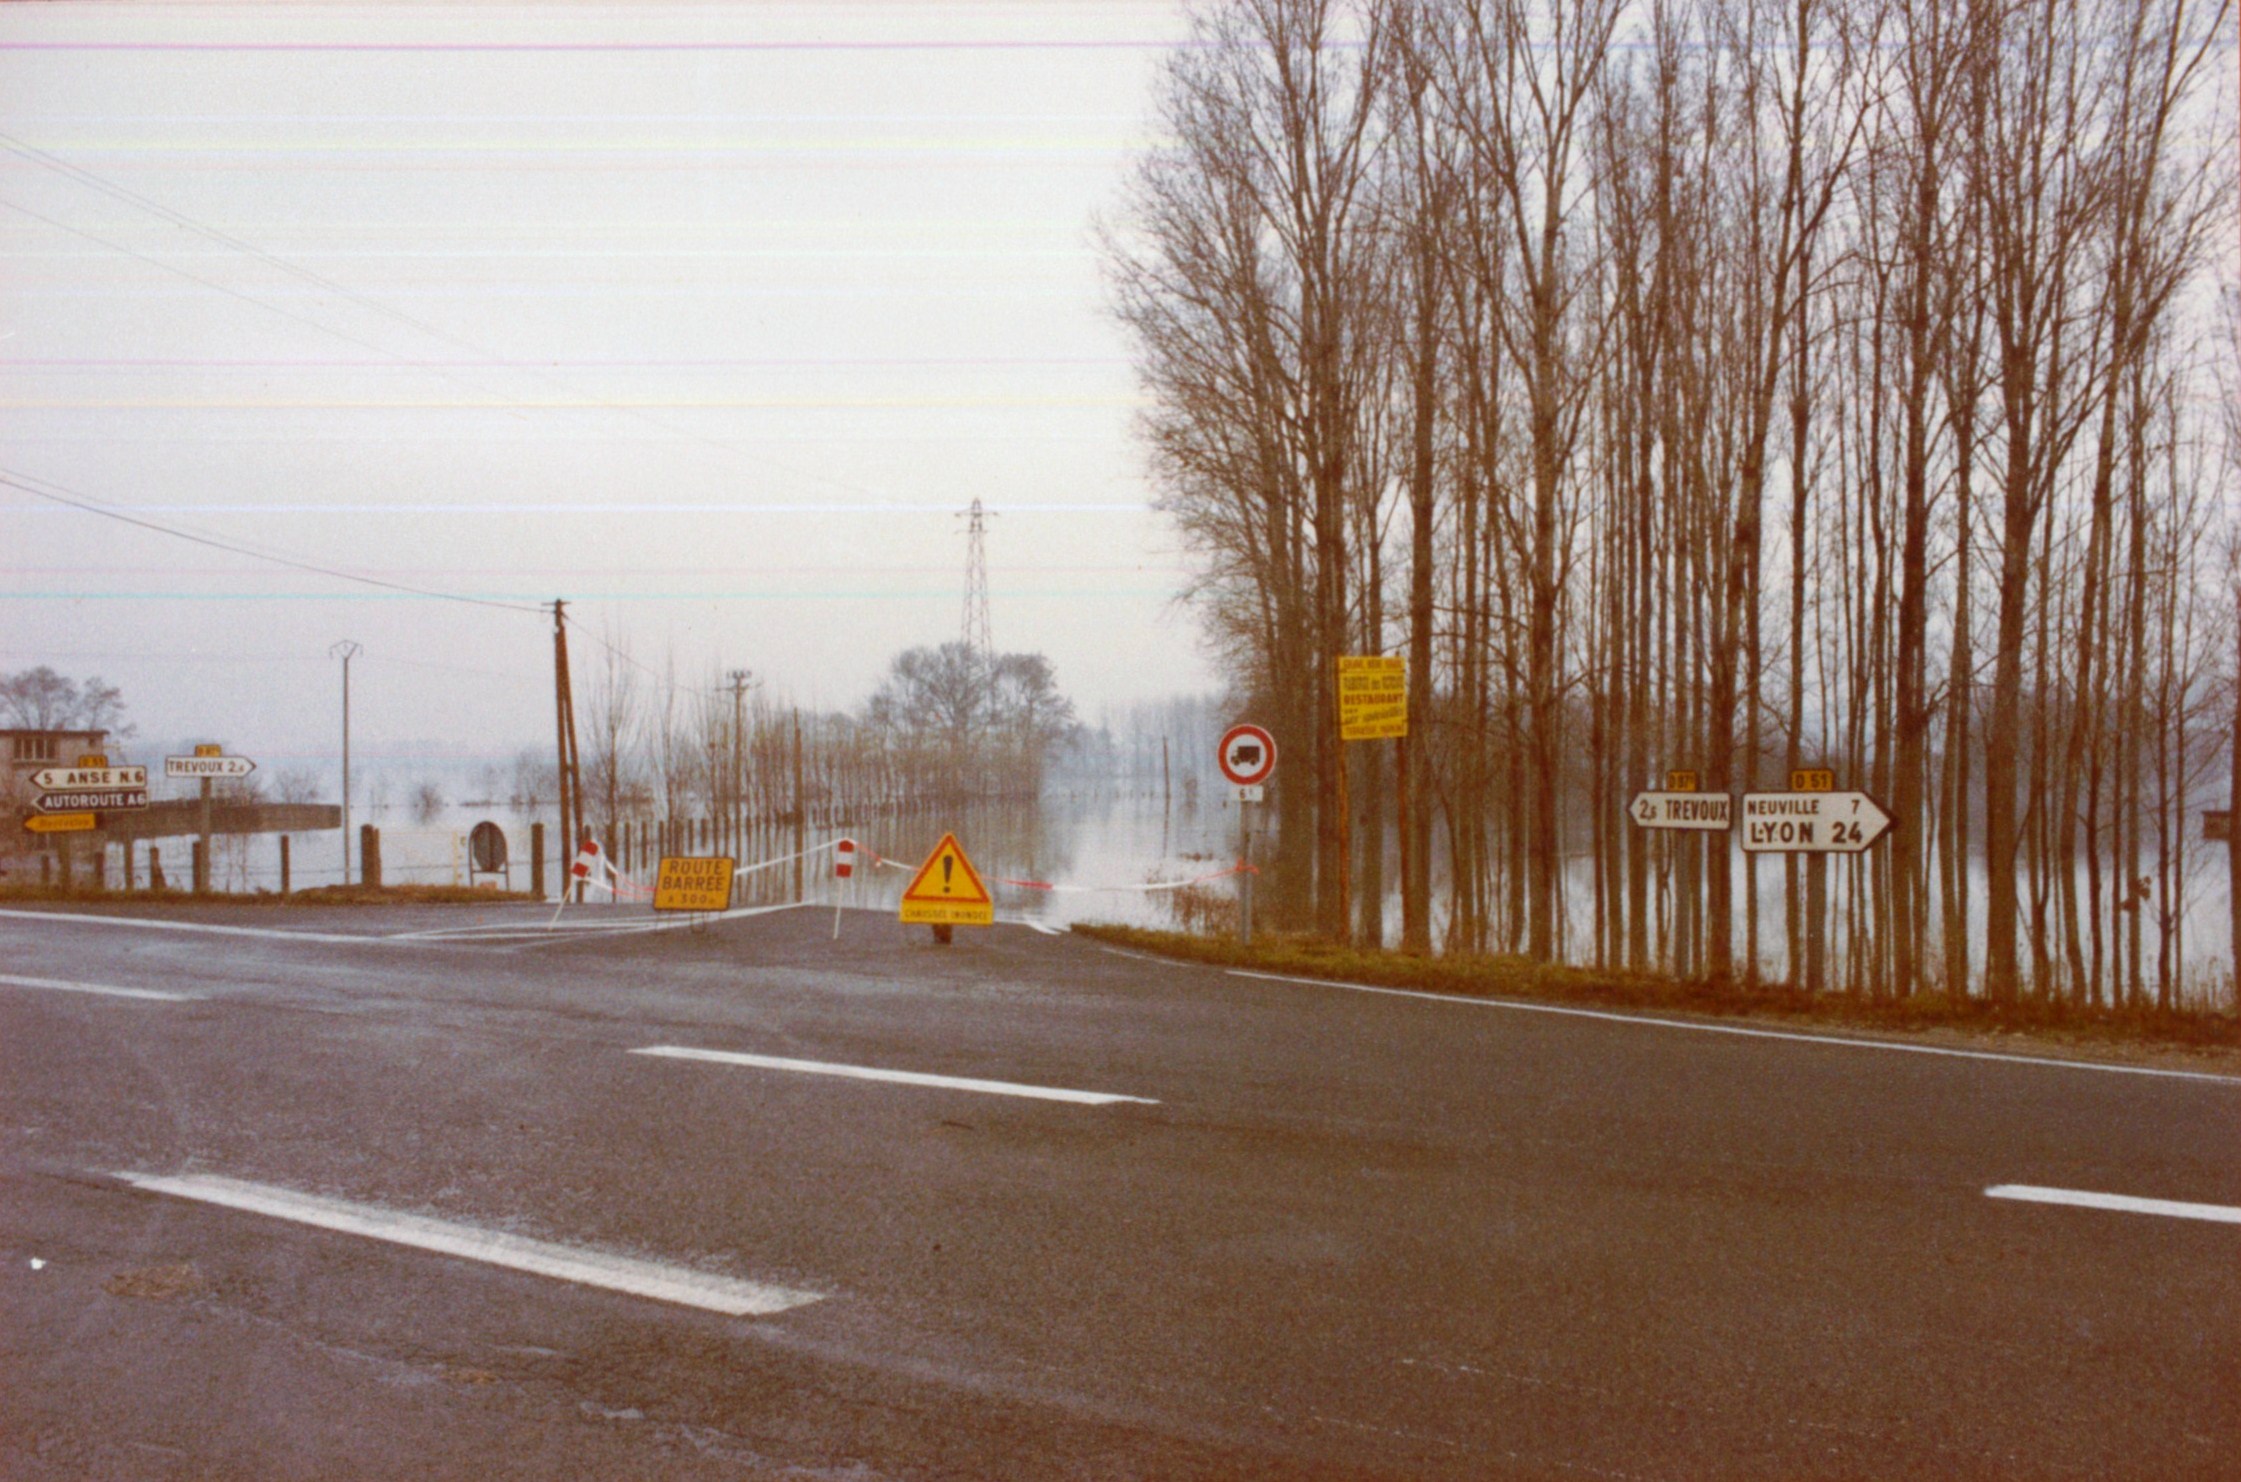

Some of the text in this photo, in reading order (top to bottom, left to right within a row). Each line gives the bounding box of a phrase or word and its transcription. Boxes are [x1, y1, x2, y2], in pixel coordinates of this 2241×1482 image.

[1343, 693, 1404, 705] RESTAURANT
[168, 761, 223, 773] TREVOUX
[44, 773, 53, 784] 5
[67, 771, 110, 784] ANSE
[1795, 773, 1828, 788] D 51
[45, 794, 124, 808] AUTOROUTE
[1747, 799, 1861, 815] NEUVILLE 7
[1665, 800, 1729, 820] TREVOUX
[1751, 821, 1862, 843] LYON 24
[669, 861, 724, 875] ROUTE
